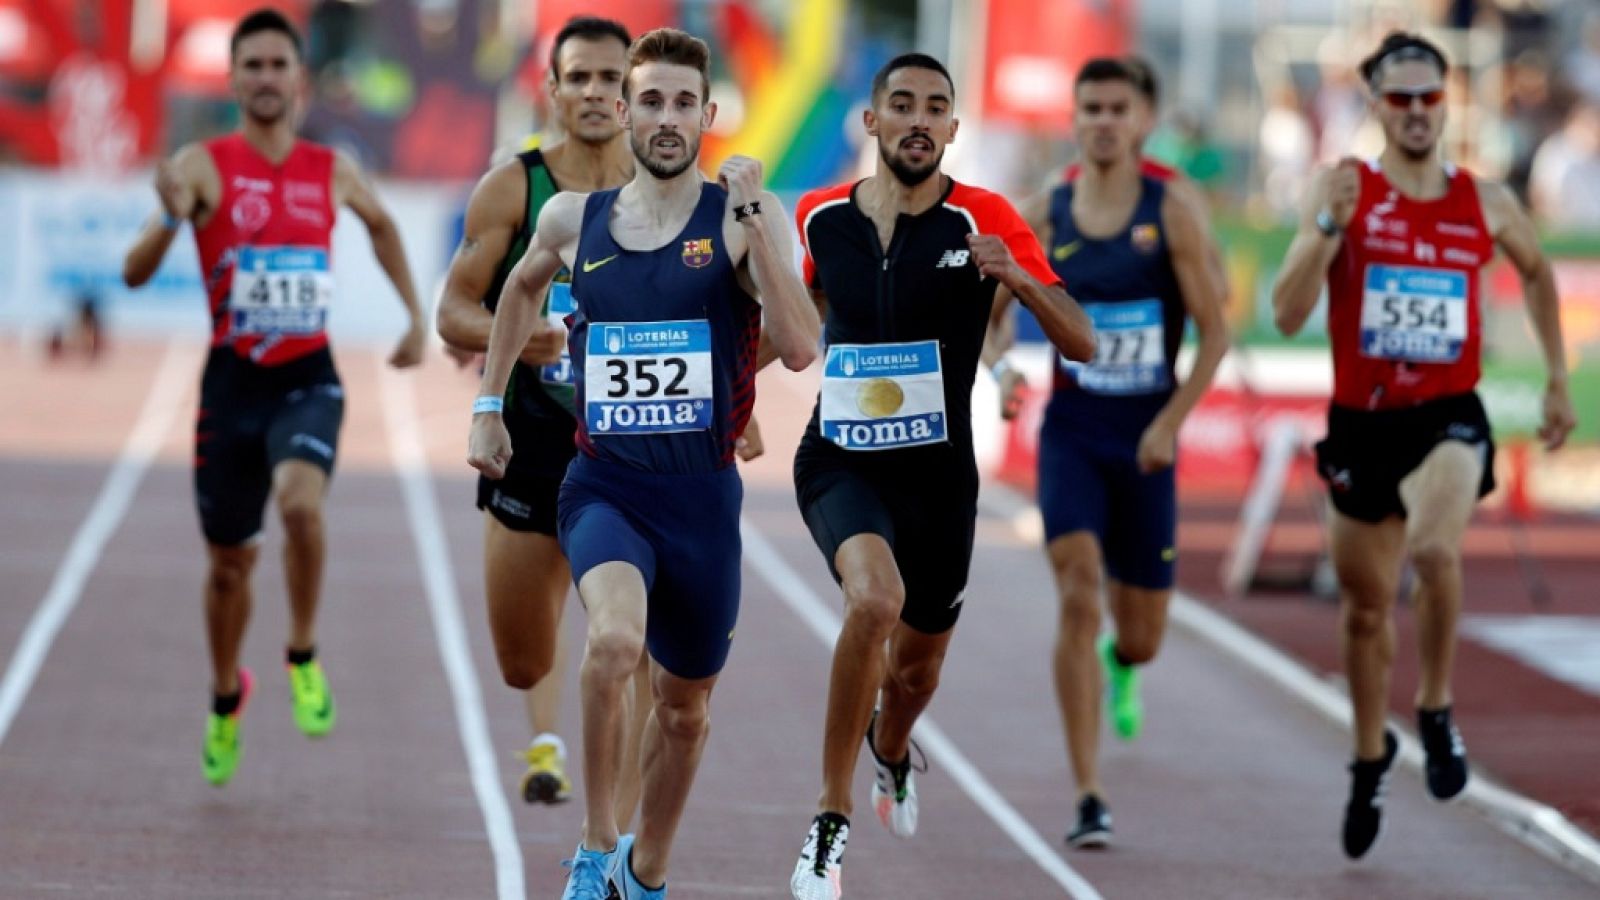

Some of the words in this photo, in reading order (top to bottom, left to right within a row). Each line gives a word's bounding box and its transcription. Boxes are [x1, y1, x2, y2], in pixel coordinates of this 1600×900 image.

[1382, 296, 1447, 330] 554
[628, 329, 689, 342] LOTERÍAS
[861, 352, 919, 365] LOTERÍAS
[605, 357, 689, 398] 352
